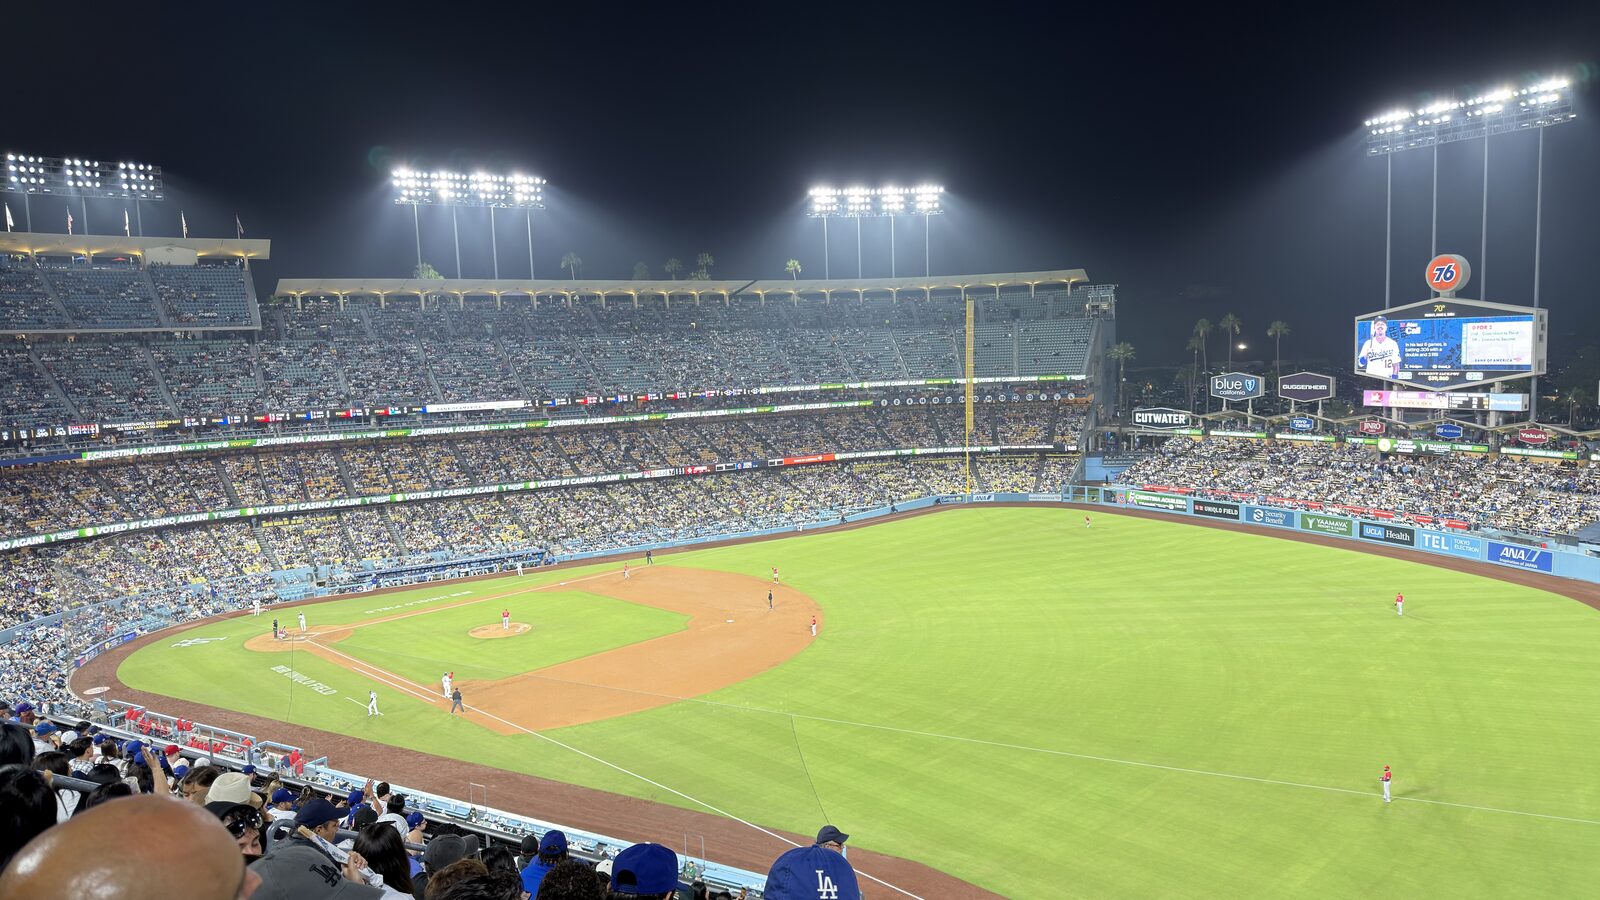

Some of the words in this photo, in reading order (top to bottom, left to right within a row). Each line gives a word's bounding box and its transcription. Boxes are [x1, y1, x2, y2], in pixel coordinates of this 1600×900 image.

[1433, 263, 1456, 283] 76
[1368, 349, 1394, 360] Dodgers
[1384, 359, 1393, 368] 12
[1215, 379, 1242, 390] blue
[701, 409, 728, 417] AGUILERA
[778, 404, 804, 412] CHRISTINA
[552, 418, 585, 426] CHRISTINA
[586, 417, 616, 425] AGUILERA
[1135, 412, 1186, 424] CUTWATER
[417, 427, 454, 436] CHRISTINA
[455, 424, 490, 433] AGUILERA
[260, 436, 305, 446] CHRISTINA
[306, 434, 344, 442] AGUILERA
[94, 449, 139, 459] CHRISTINA
[140, 444, 183, 456] AGUILERA
[597, 474, 620, 482] AGAIN!
[405, 491, 432, 500] VOTED
[442, 488, 472, 496] CASINO
[472, 486, 498, 494] AGAIN!
[257, 504, 285, 514] VOTED
[299, 501, 332, 510] CASINO
[333, 498, 361, 507] AGAIN!
[1161, 497, 1186, 505] AGUILERA
[1204, 505, 1222, 514] UNIQLO
[1223, 507, 1238, 515] FIELD
[1265, 510, 1286, 519] Security
[96, 523, 127, 534] VOTED
[129, 521, 139, 529] #1
[141, 518, 175, 528] CASINO
[176, 513, 208, 523] AGAIN!
[1265, 517, 1284, 525] Benefit
[1366, 528, 1382, 536] UCLA
[1386, 530, 1410, 541] Health
[12, 536, 45, 548] AGAIN!
[1423, 534, 1449, 550] TEL
[1454, 544, 1479, 553] ELECTRON
[1500, 547, 1525, 560] ANA
[1500, 558, 1520, 566] Inspiration
[309, 864, 342, 887] LA
[815, 870, 838, 899] LA
